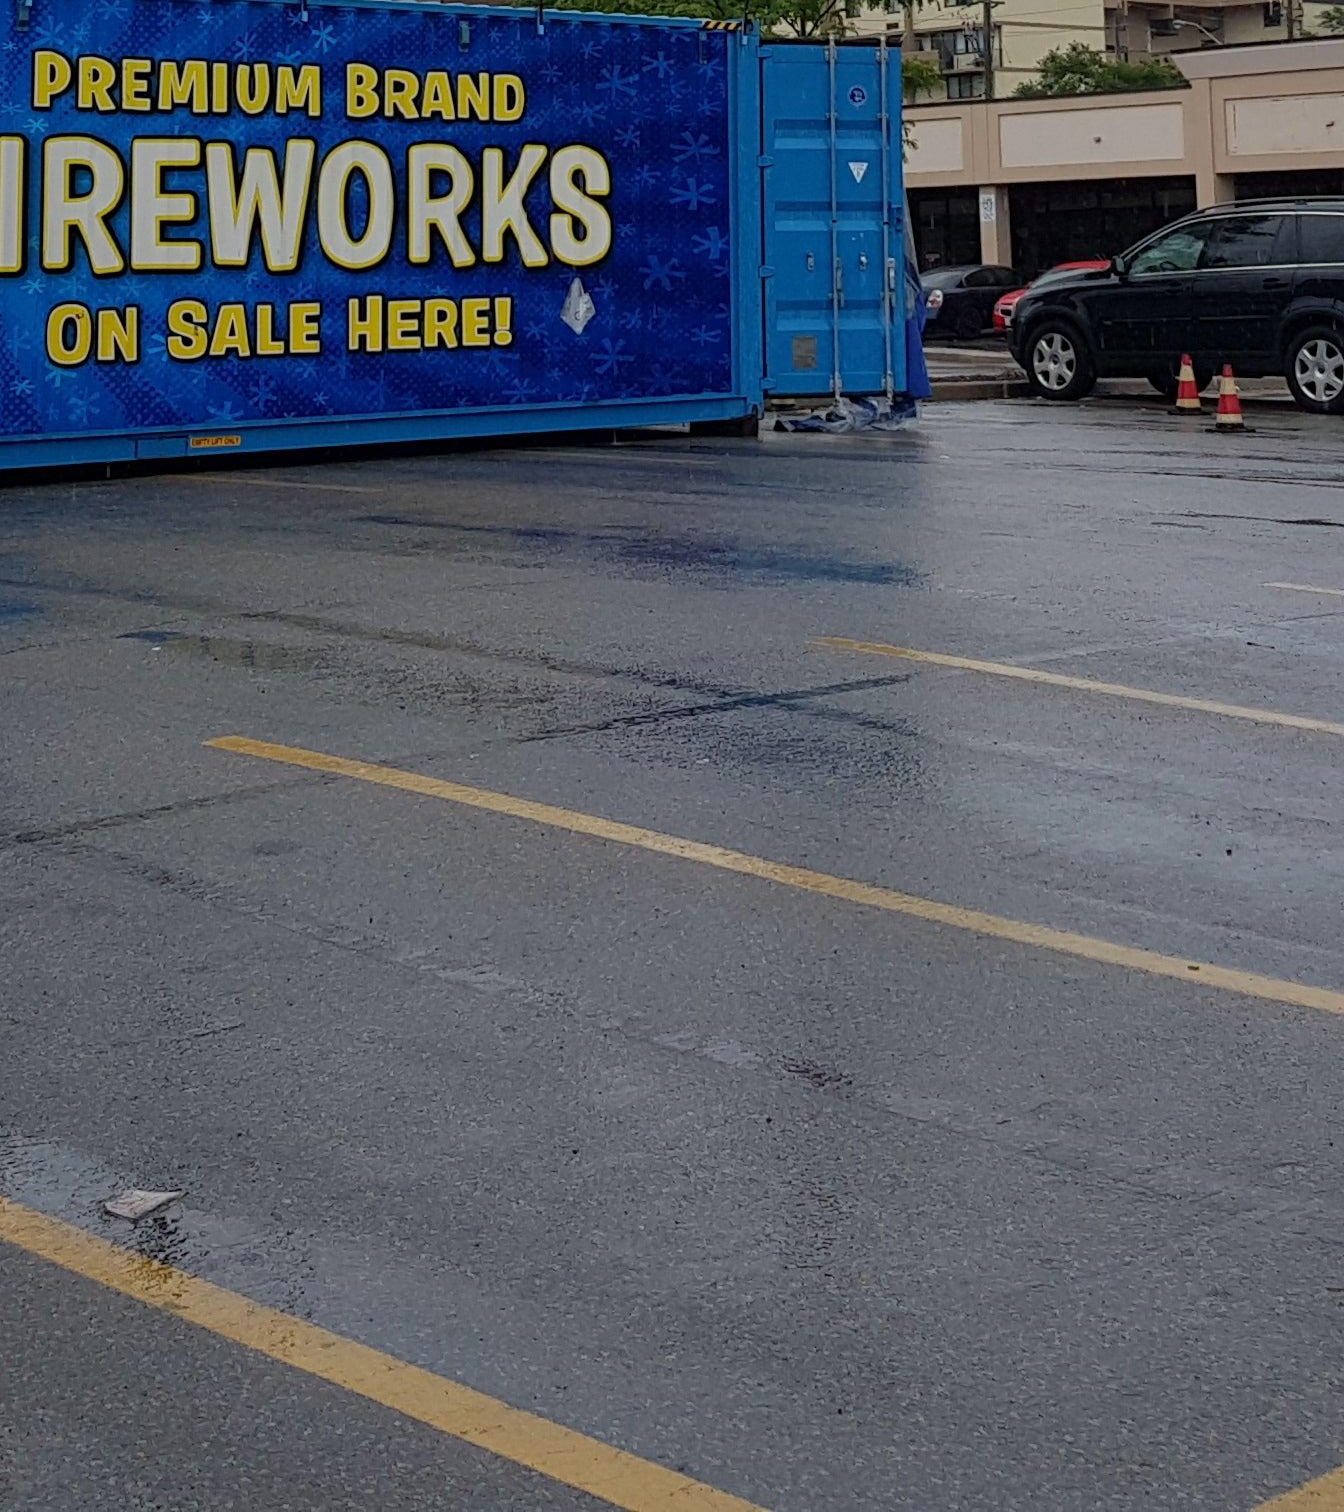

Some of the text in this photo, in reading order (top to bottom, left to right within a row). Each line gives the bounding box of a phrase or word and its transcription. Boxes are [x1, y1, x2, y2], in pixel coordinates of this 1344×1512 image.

[32, 50, 526, 122] PREMIUM BRAND
[45, 294, 514, 366] ON SALE HERE!
